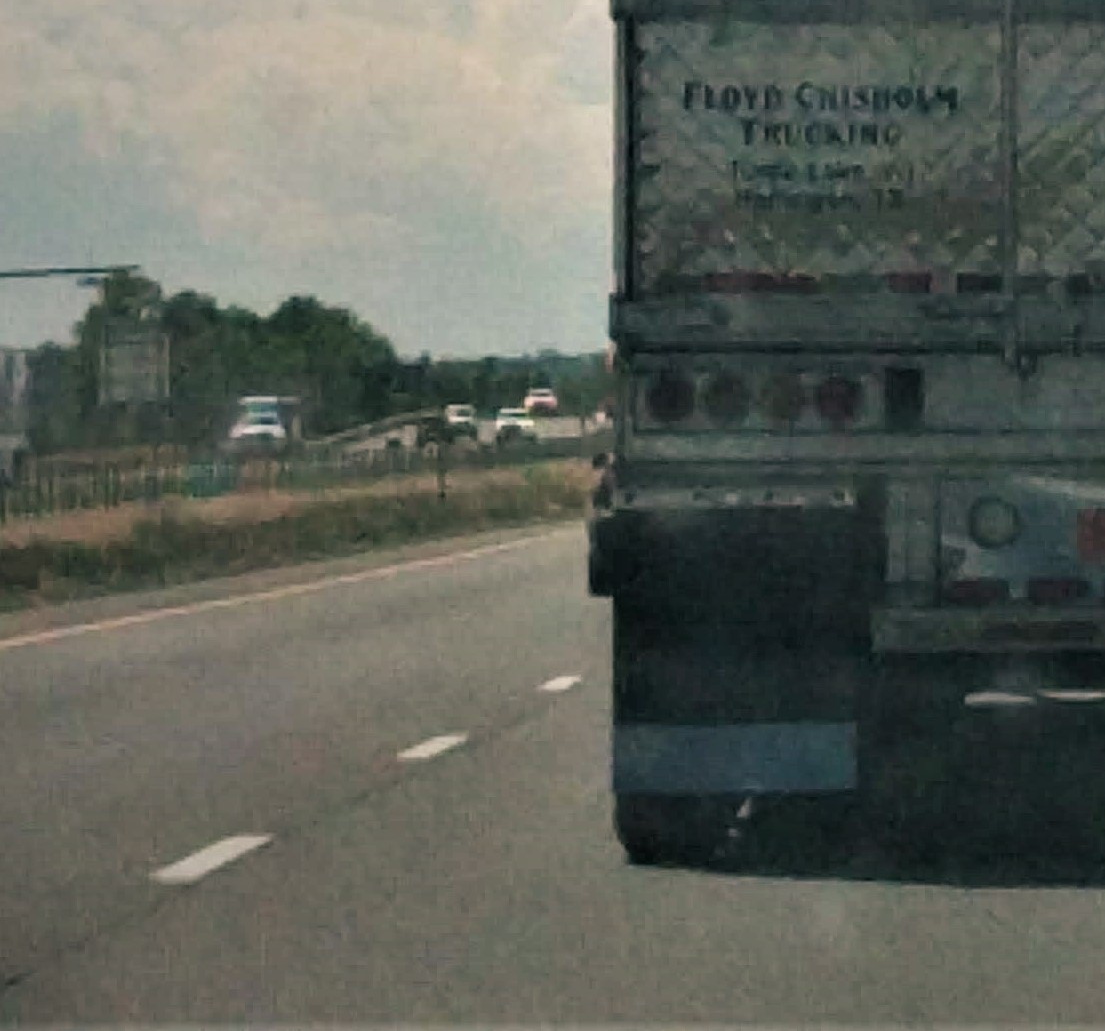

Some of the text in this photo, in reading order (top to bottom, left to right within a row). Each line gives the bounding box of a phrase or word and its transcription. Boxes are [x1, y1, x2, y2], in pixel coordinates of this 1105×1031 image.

[683, 80, 959, 113] FLOYD CHISHOLM
[739, 119, 903, 147] TRUCKING
